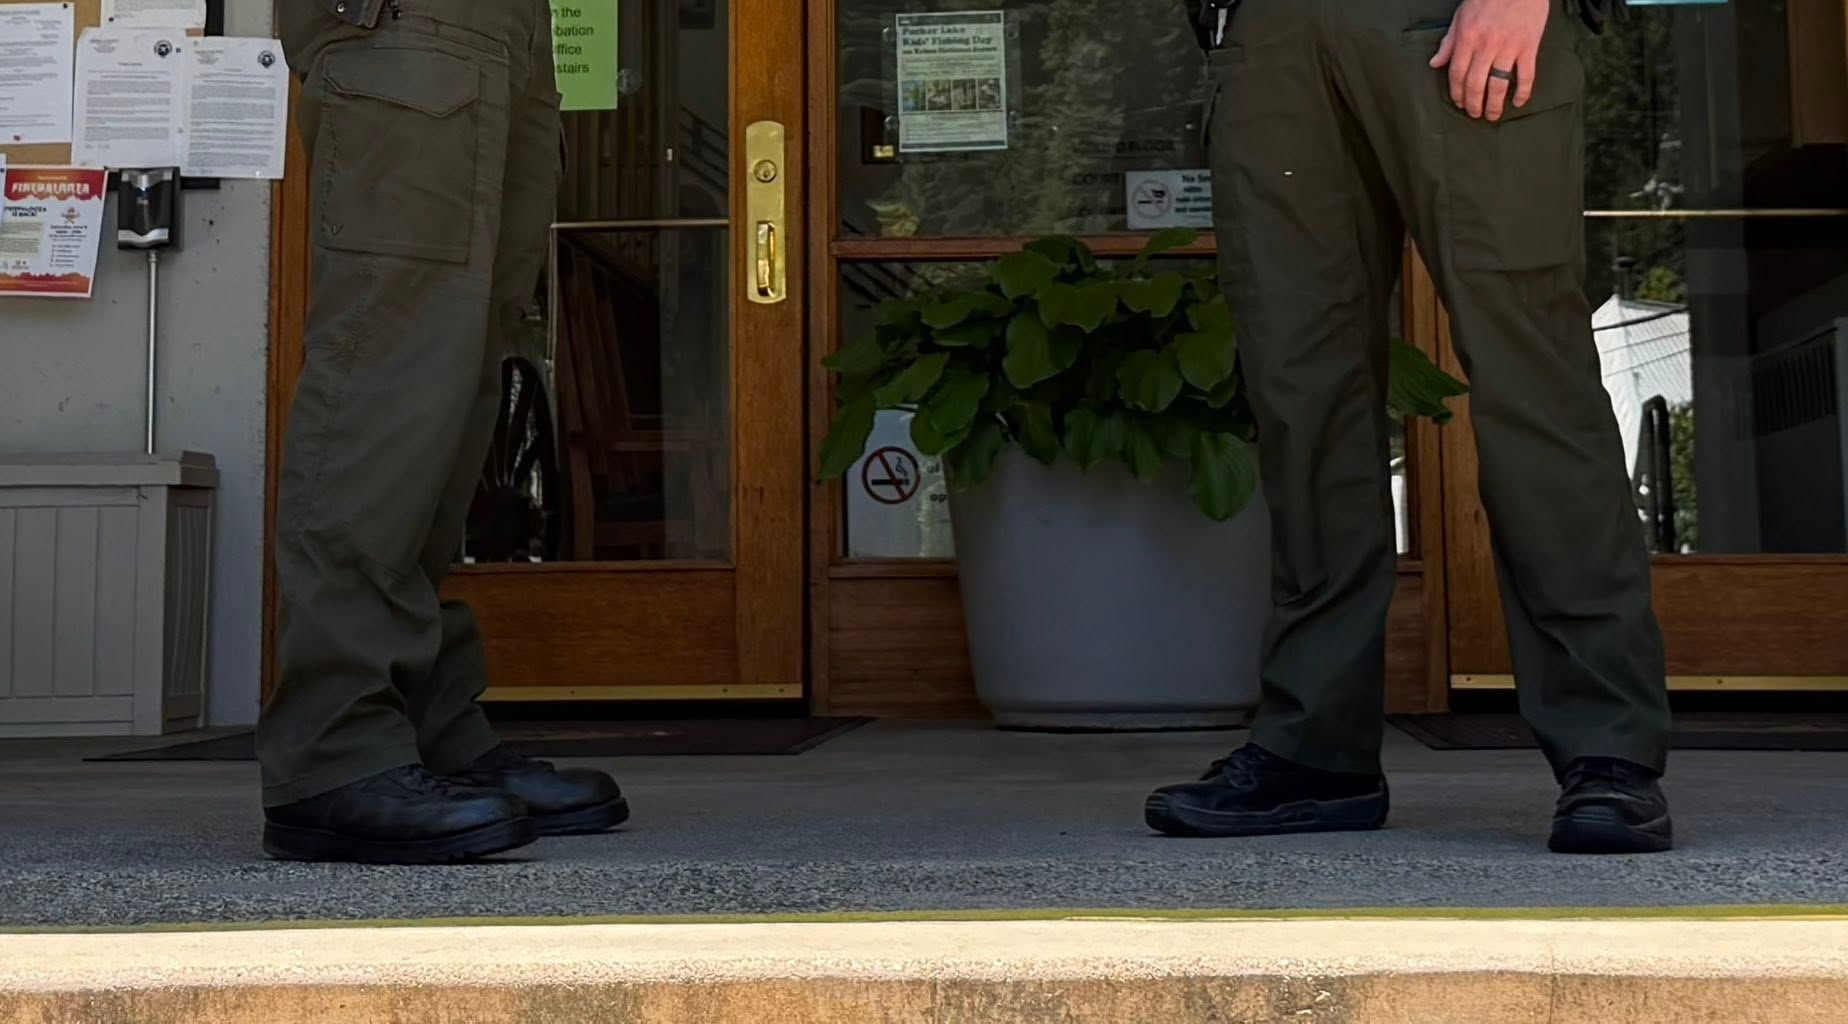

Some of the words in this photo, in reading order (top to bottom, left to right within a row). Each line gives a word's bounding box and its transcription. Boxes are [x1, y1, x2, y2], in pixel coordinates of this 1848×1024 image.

[561, 7, 582, 18] the
[941, 26, 967, 34] Lake
[931, 36, 971, 46] Fishing
[973, 36, 993, 45] Day
[554, 44, 582, 55] ffice
